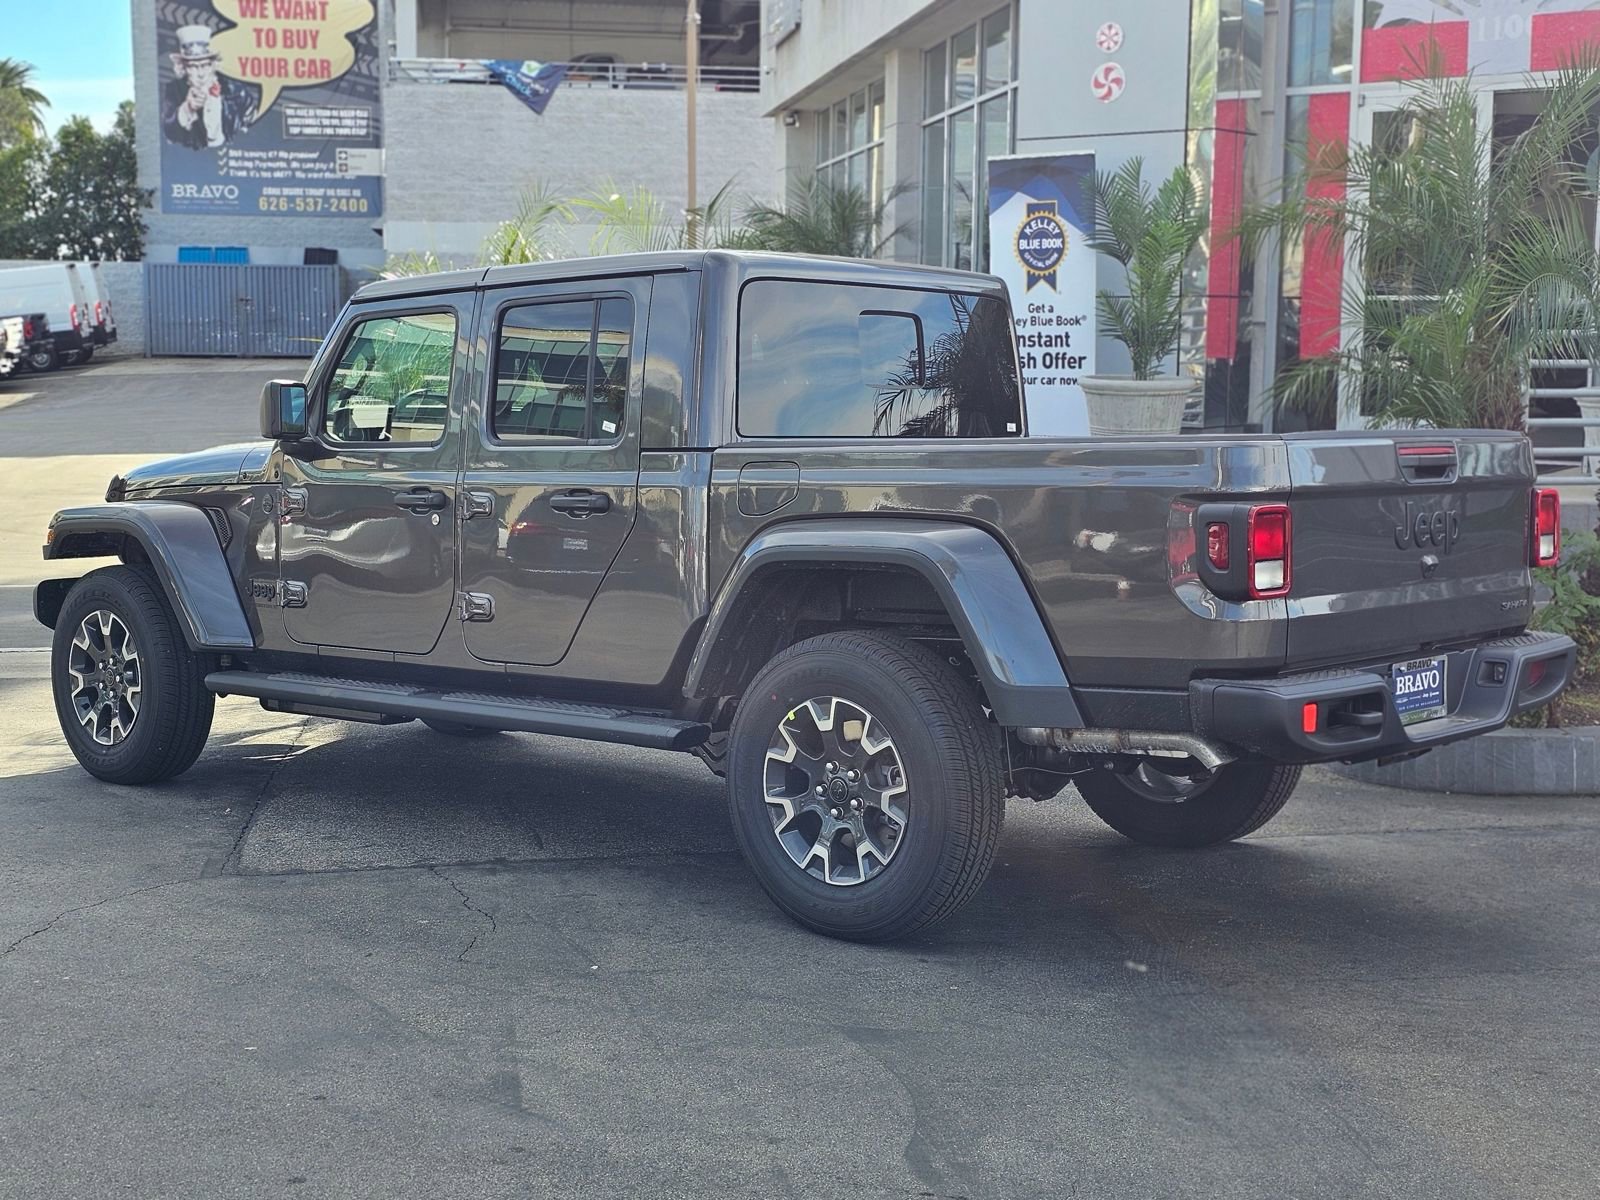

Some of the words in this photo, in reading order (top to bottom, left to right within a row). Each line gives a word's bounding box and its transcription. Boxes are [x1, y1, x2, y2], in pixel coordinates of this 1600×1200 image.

[238, 0, 269, 18] WE
[273, 0, 329, 21] WANT
[253, 28, 277, 48] TO
[282, 29, 320, 49] BUY
[238, 56, 288, 78] YOUR
[294, 58, 331, 79] CAR
[171, 184, 239, 199] BRAVO
[259, 196, 367, 212] 626-537-2400
[1024, 218, 1060, 236] KELLEY
[1019, 239, 1040, 250] BLUE
[1041, 238, 1063, 249] BOOK
[1028, 303, 1045, 314] Get
[1047, 304, 1054, 314] a
[1030, 315, 1054, 326] Blue
[1016, 331, 1071, 348] nstant
[1042, 352, 1087, 370] Offer
[1022, 376, 1038, 385] our
[1040, 377, 1057, 385] car
[1394, 500, 1460, 554] Jeep
[248, 578, 276, 602] Jeep
[1406, 658, 1432, 671] BRAVO
[1395, 669, 1440, 696] BRAVO
